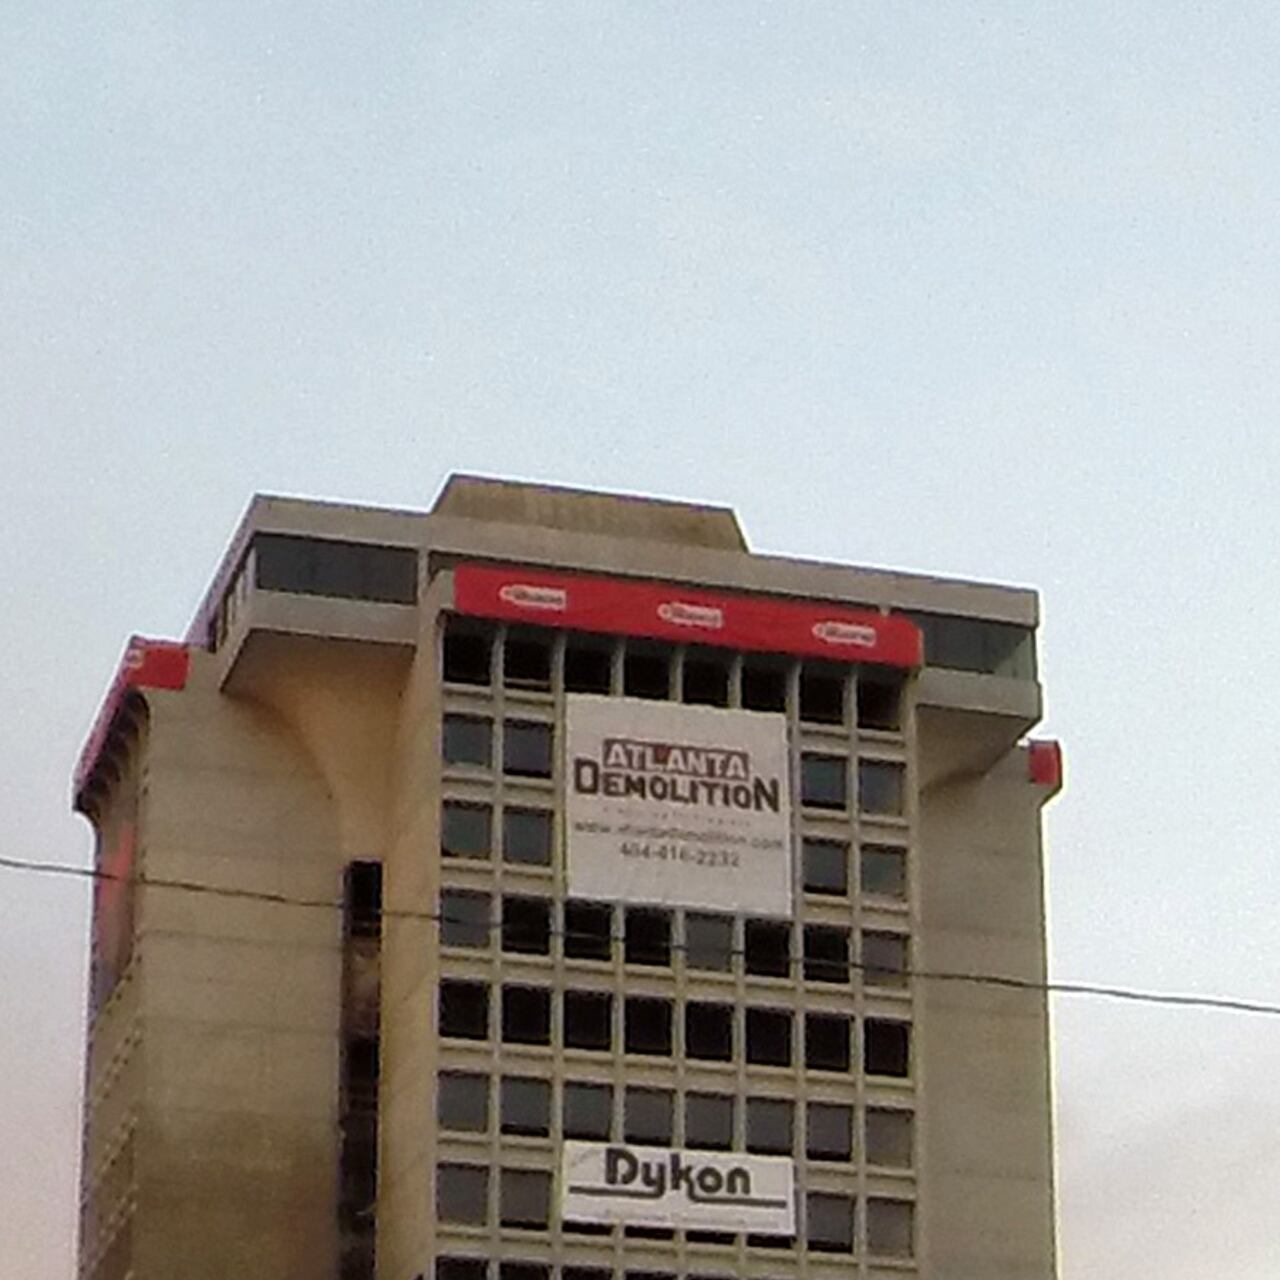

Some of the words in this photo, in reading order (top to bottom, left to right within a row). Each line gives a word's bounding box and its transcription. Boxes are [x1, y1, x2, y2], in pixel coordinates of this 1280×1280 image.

[575, 757, 779, 813] DEMOLITION
[606, 741, 748, 780] ATLANTA
[604, 1147, 752, 1199] Dykon
